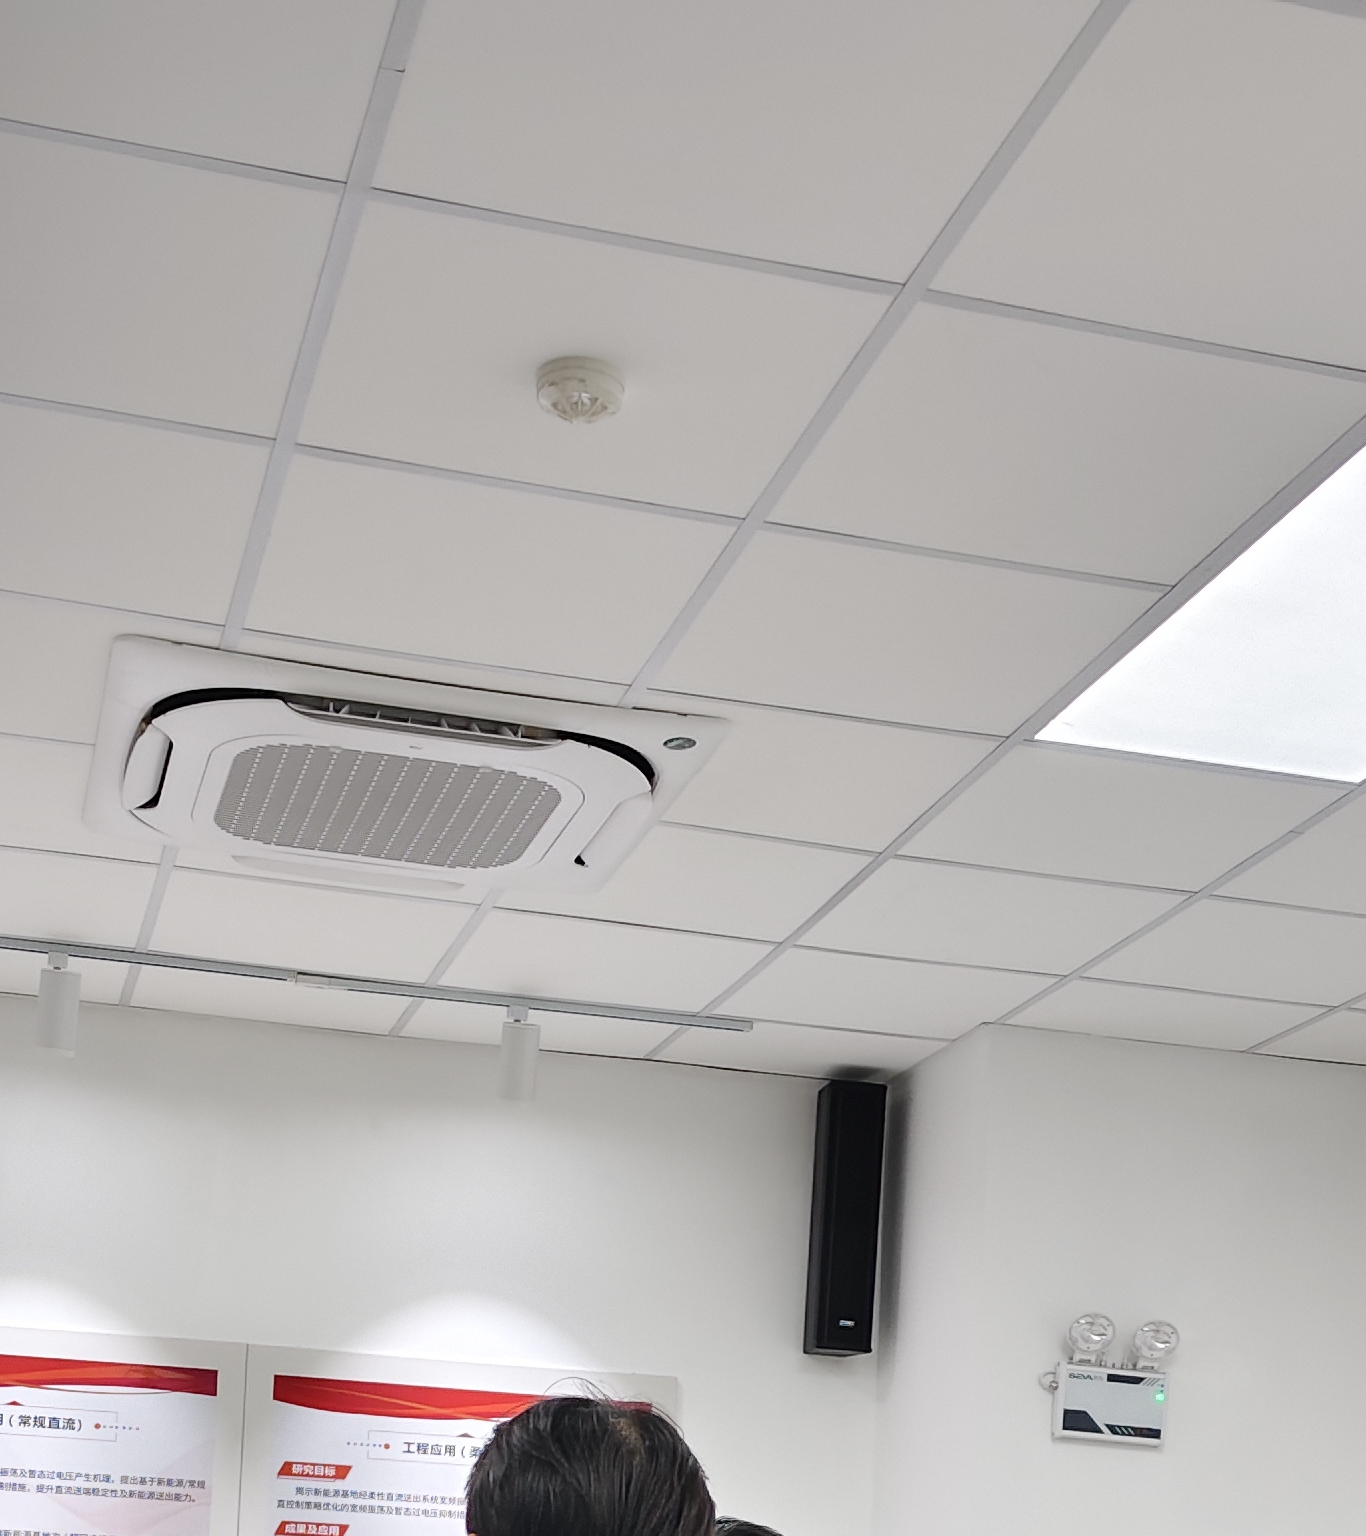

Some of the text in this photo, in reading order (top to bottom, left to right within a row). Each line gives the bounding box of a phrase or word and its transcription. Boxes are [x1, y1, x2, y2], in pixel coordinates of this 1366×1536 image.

[291, 1463, 336, 1477] 研究目标
[284, 1522, 339, 1536] 成果及应用
